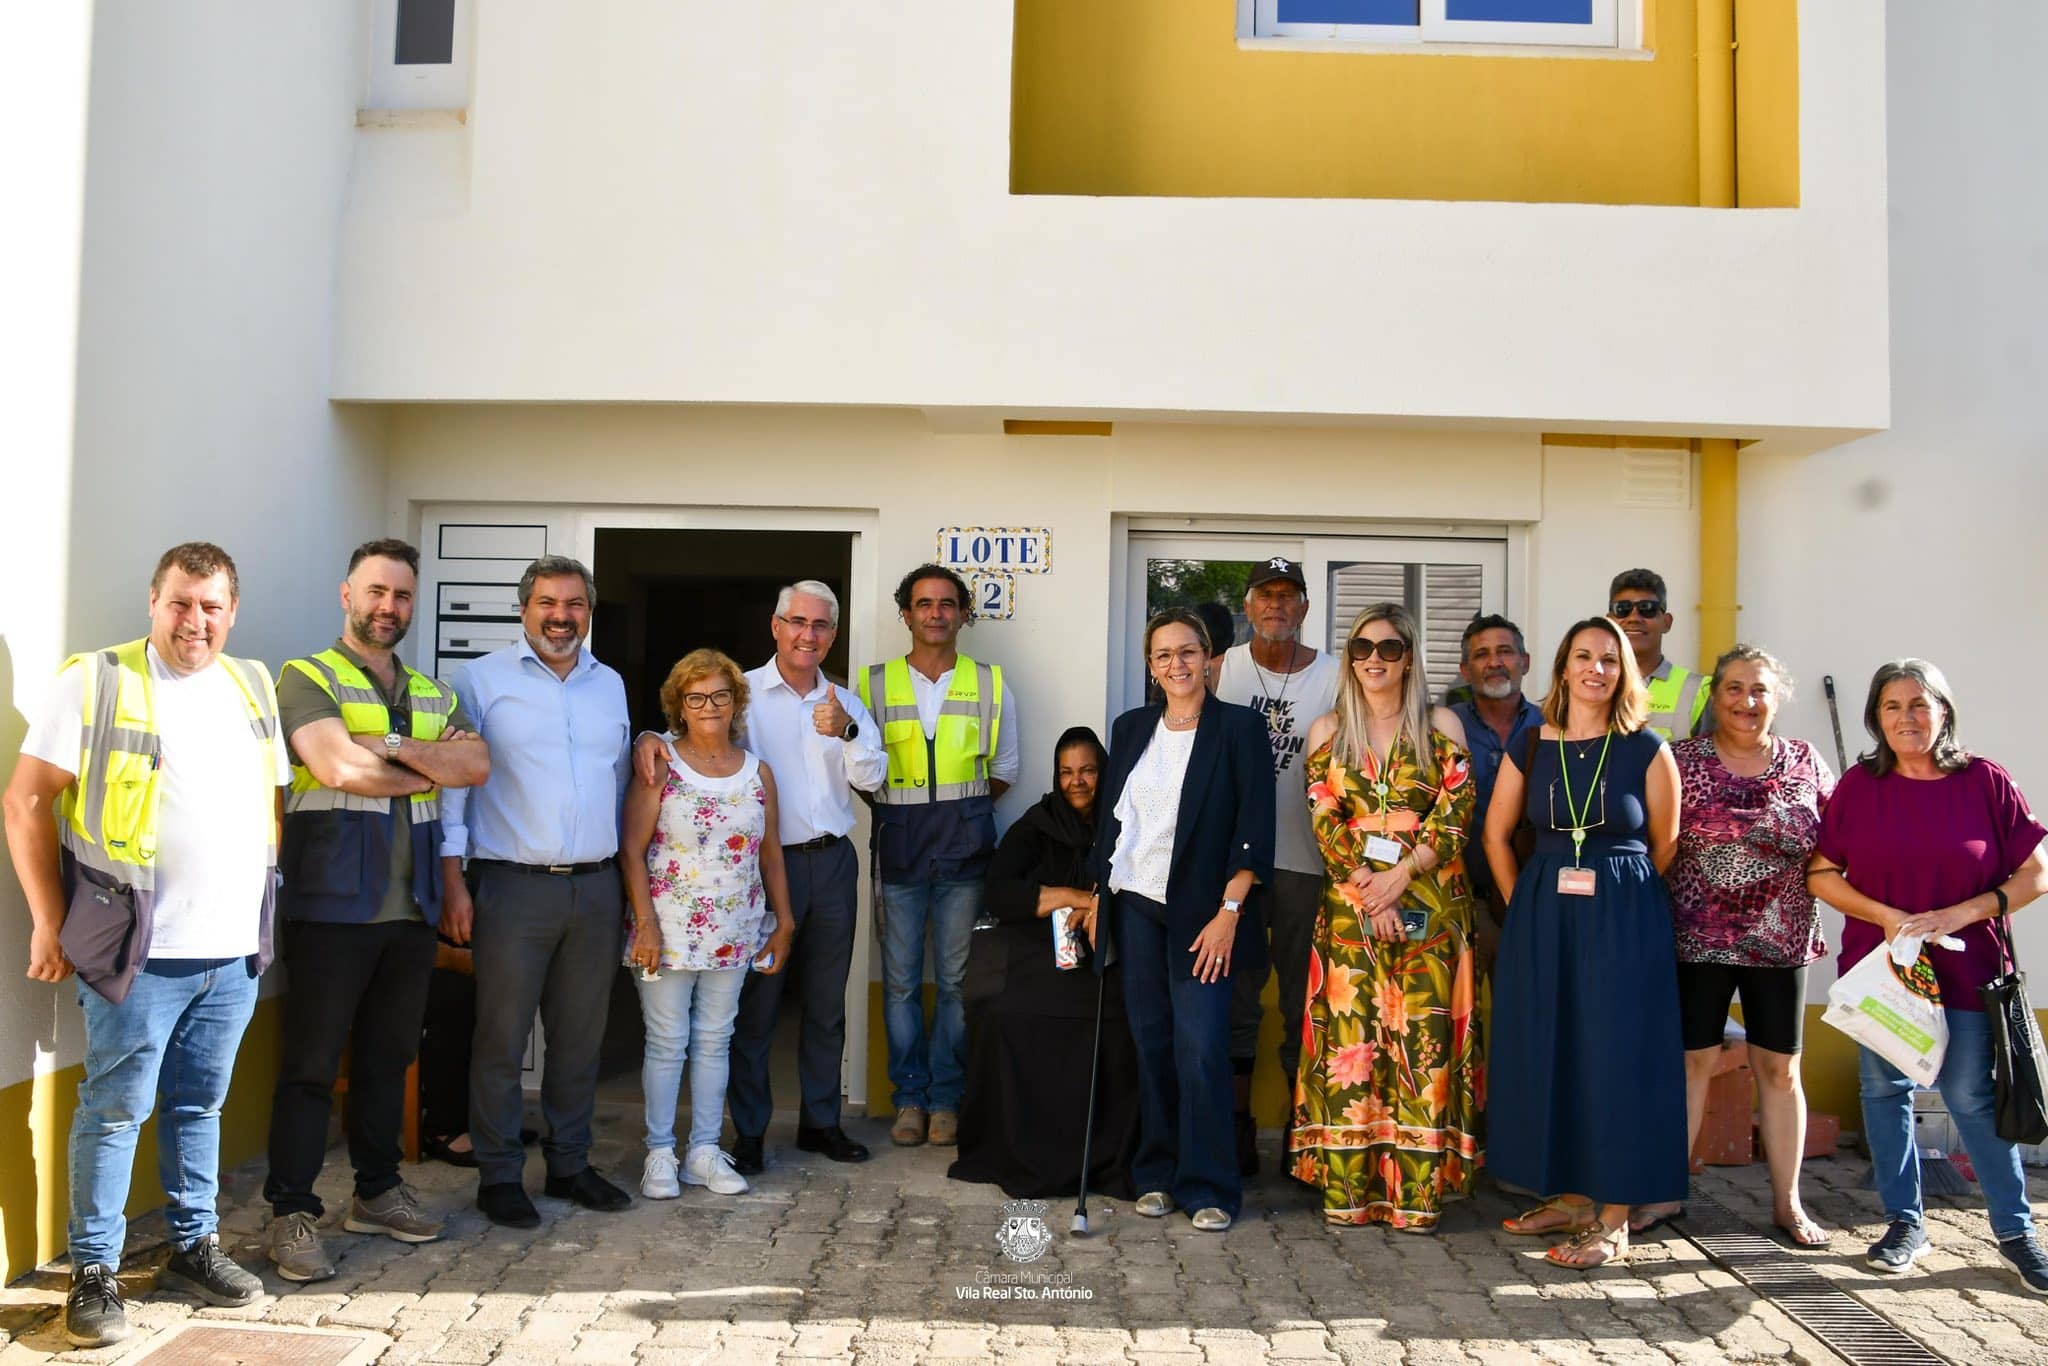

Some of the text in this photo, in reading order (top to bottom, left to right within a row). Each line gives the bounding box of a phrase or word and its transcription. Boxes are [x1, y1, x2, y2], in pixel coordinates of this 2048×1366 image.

[949, 536, 1038, 564] LOTE
[1269, 558, 1289, 573] NY
[983, 582, 1002, 610] 2
